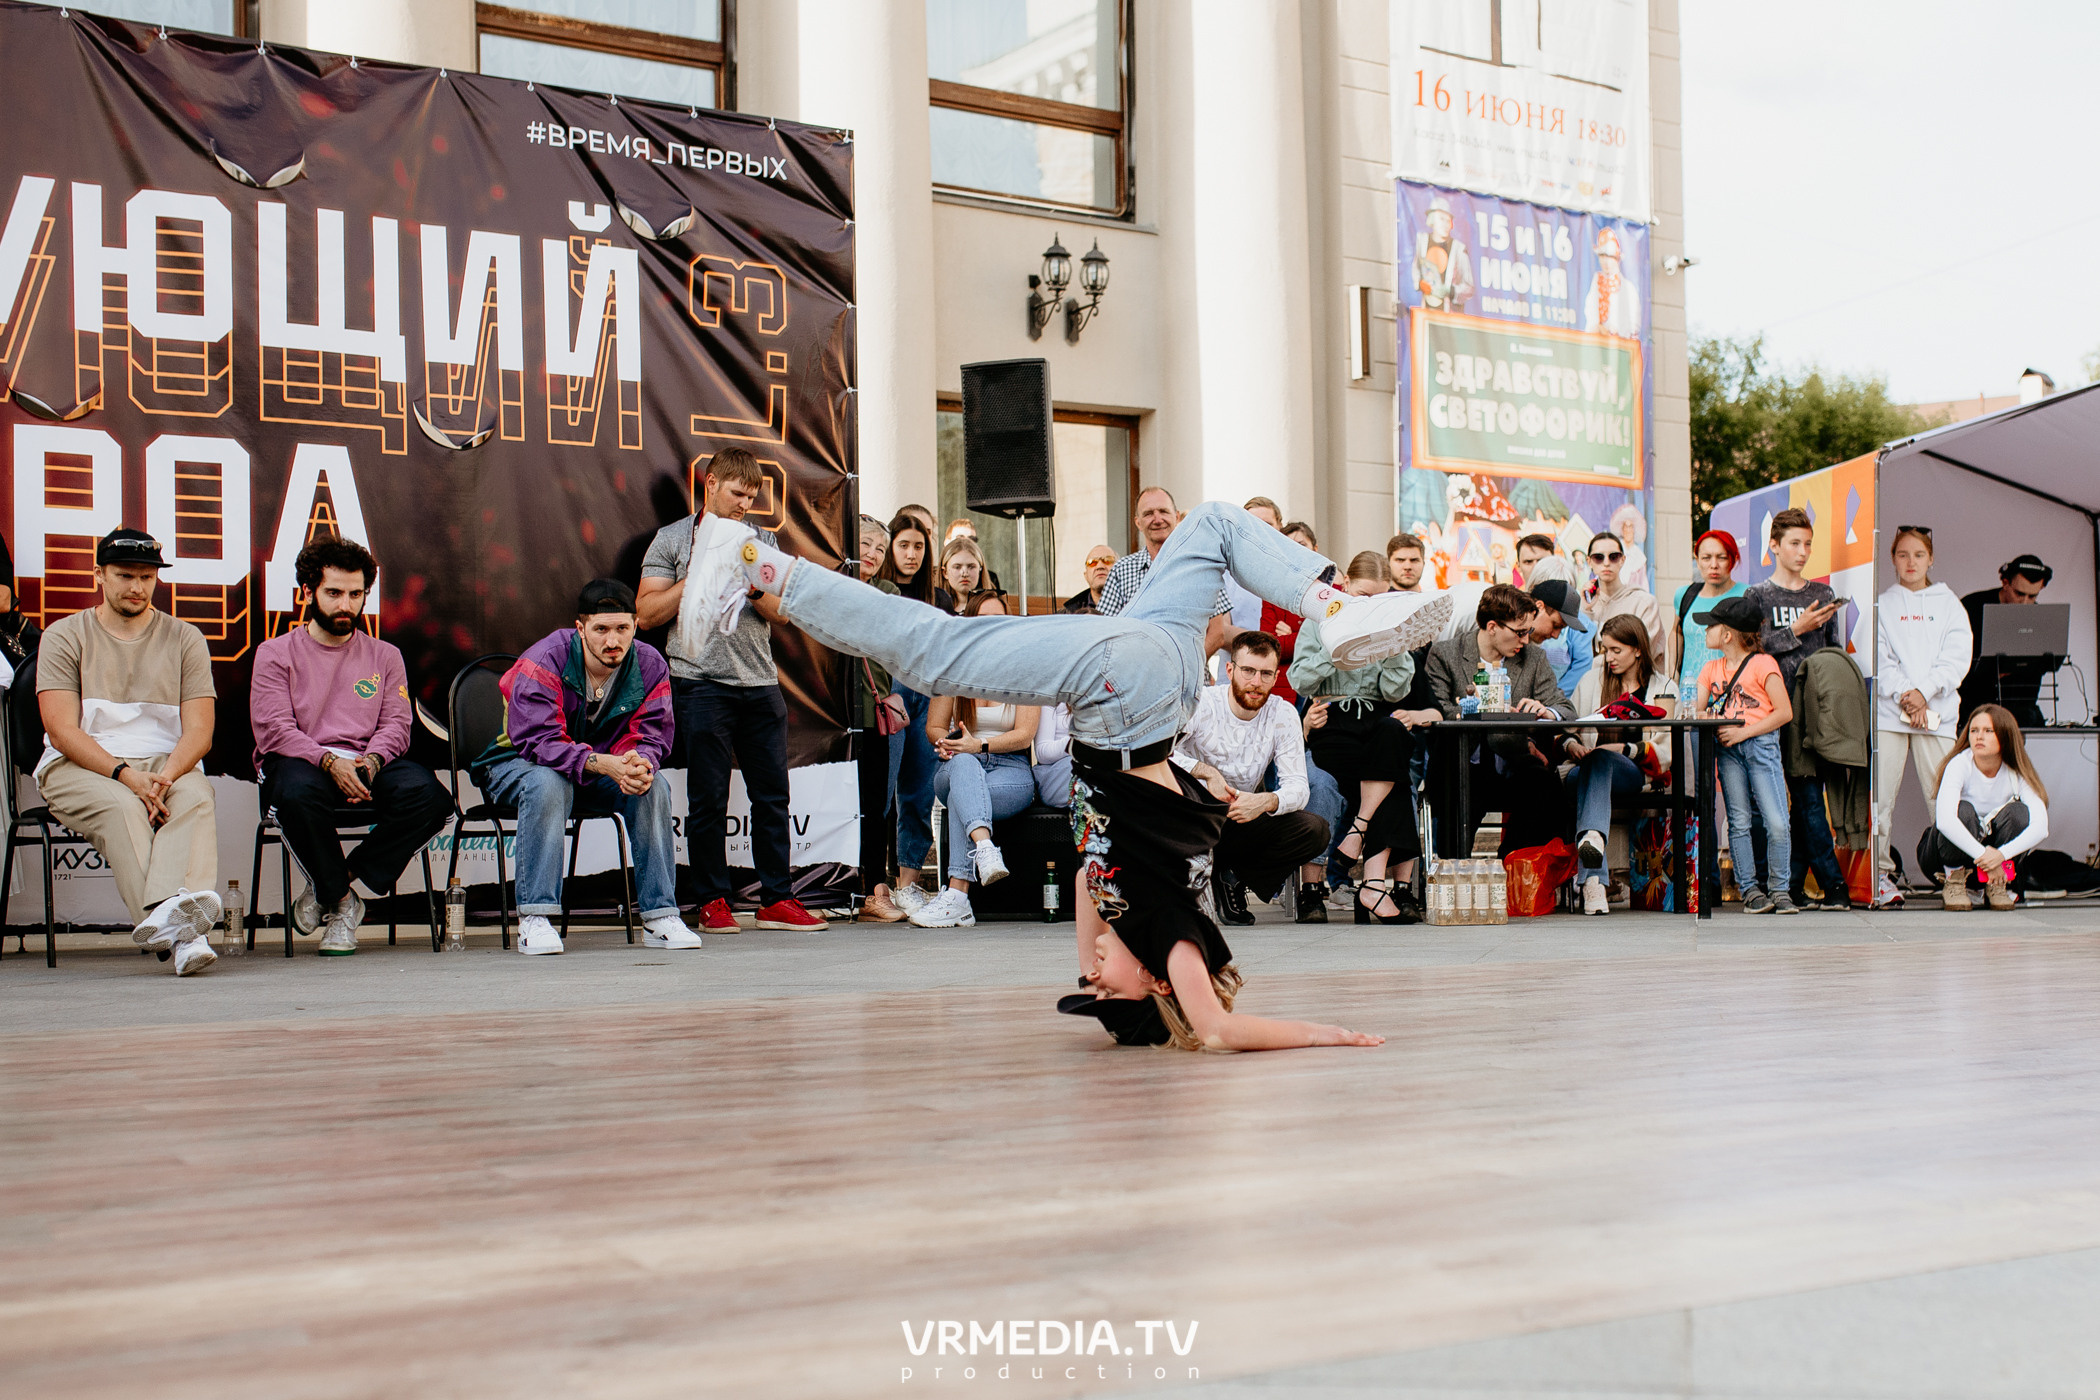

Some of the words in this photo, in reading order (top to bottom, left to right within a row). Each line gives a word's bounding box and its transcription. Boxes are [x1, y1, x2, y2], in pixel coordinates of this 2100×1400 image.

[1413, 69, 1451, 112] 16
[1465, 90, 1566, 135] ИЮНЯ
[1578, 118, 1626, 149] 18:30
[526, 120, 788, 181] #ВРЕМЯ_ПЕРВЫХ
[1475, 211, 1511, 251] 15
[1539, 222, 1574, 262] 16
[1479, 256, 1568, 300] ИЮНЯ
[1429, 393, 1631, 448] СВЕТОФОРИК!
